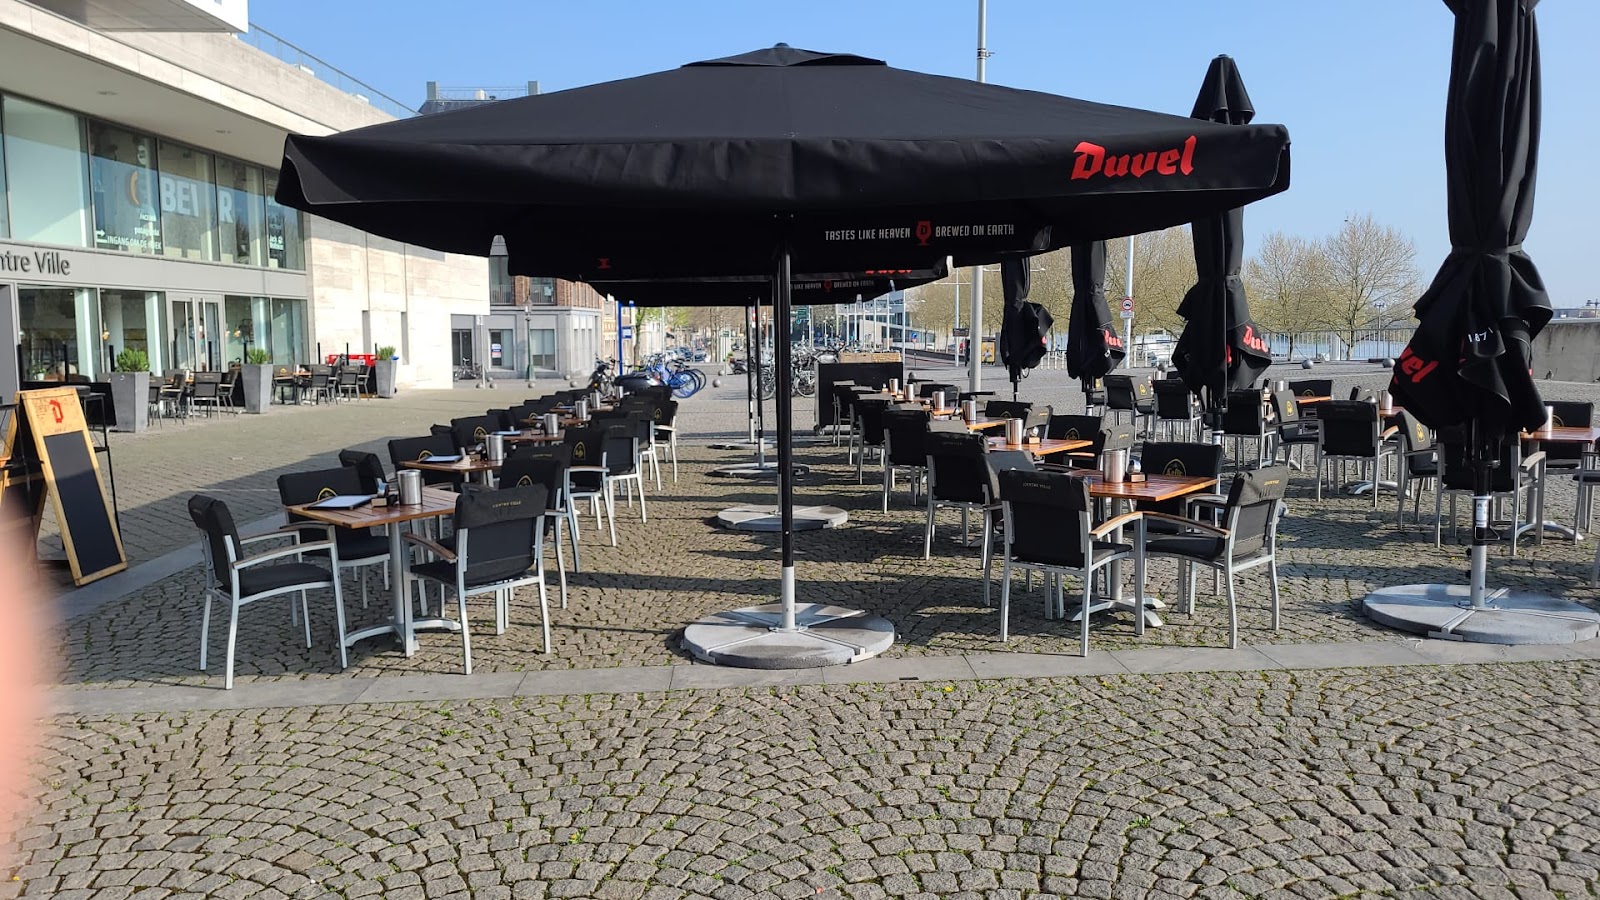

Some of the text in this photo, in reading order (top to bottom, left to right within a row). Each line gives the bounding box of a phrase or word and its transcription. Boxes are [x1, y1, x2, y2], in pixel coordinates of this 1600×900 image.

[1071, 135, 1197, 180] Duvel
[825, 230, 856, 241] TASTES
[858, 229, 876, 240] LIKE
[879, 227, 911, 239] HEAVEN
[935, 225, 970, 237] BREWED
[972, 225, 985, 236] ON
[987, 224, 1015, 236] EARTH
[34, 251, 71, 276] Ville
